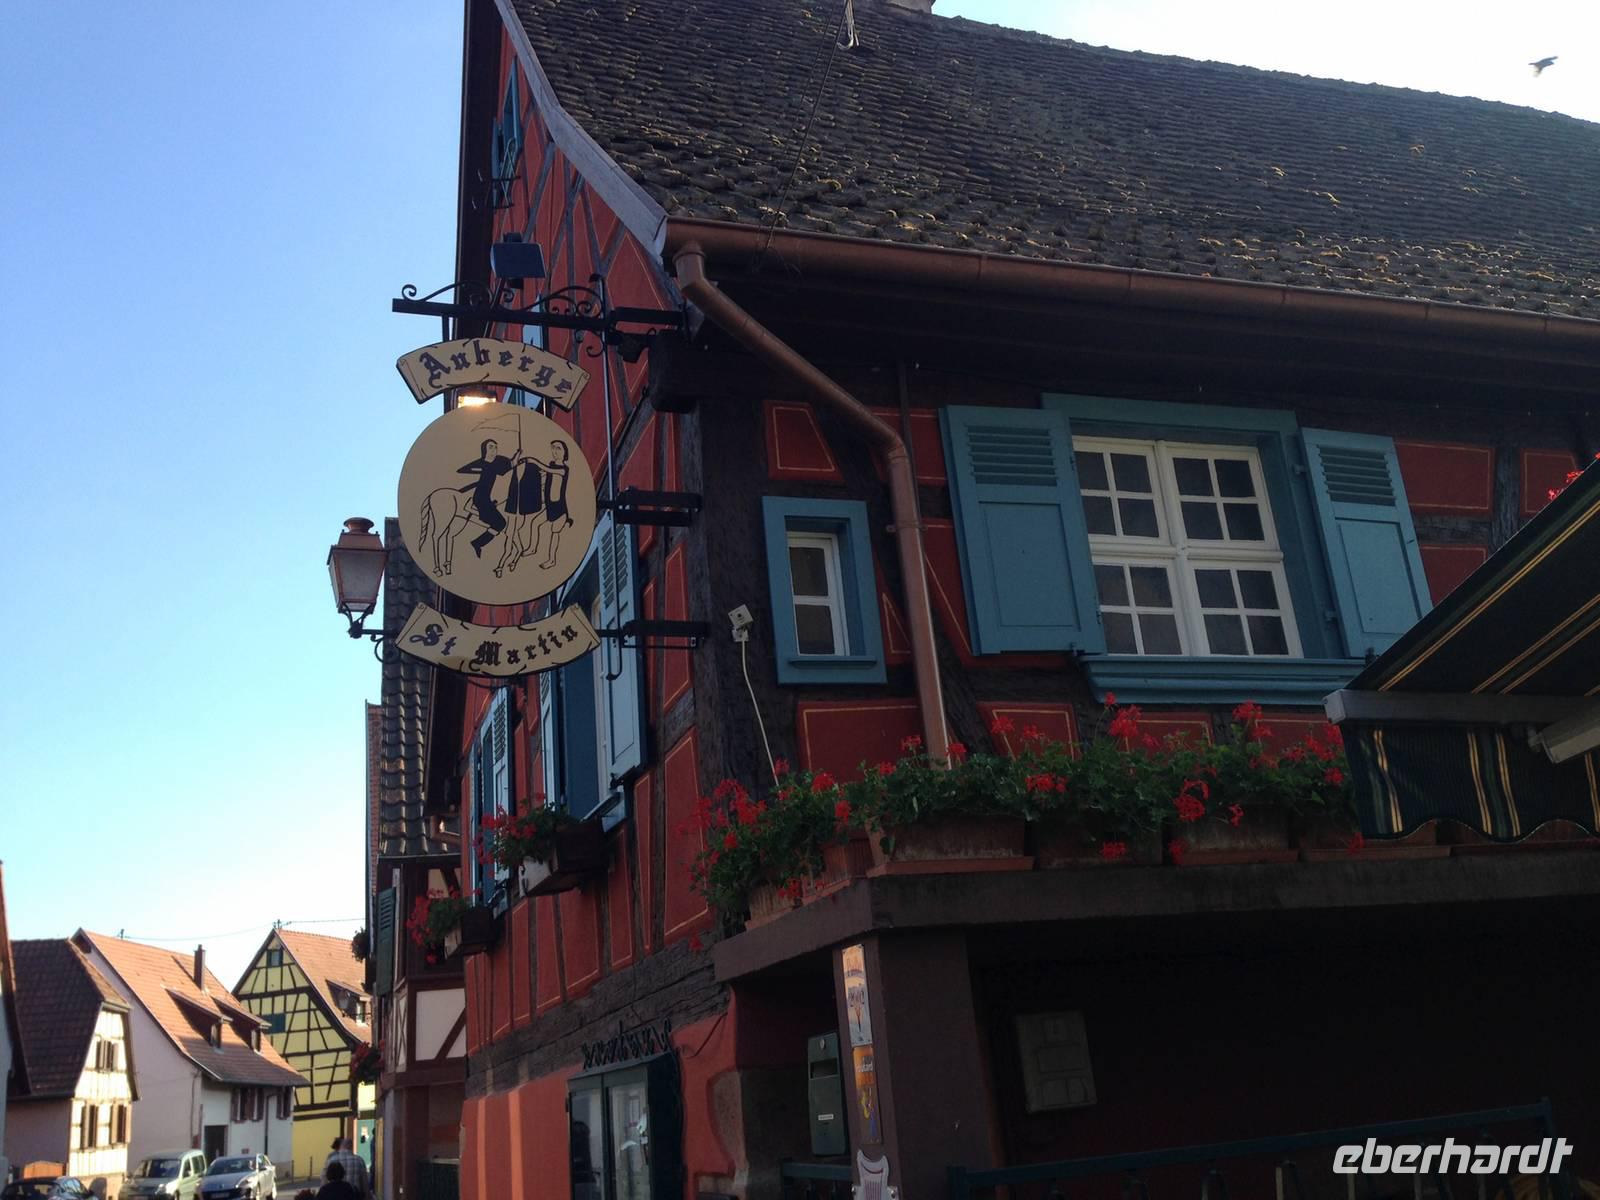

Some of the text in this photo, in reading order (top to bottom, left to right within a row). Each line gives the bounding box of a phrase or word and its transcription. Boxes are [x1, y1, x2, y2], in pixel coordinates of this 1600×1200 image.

[419, 339, 573, 393] Auberge
[409, 623, 578, 672] St Martin
